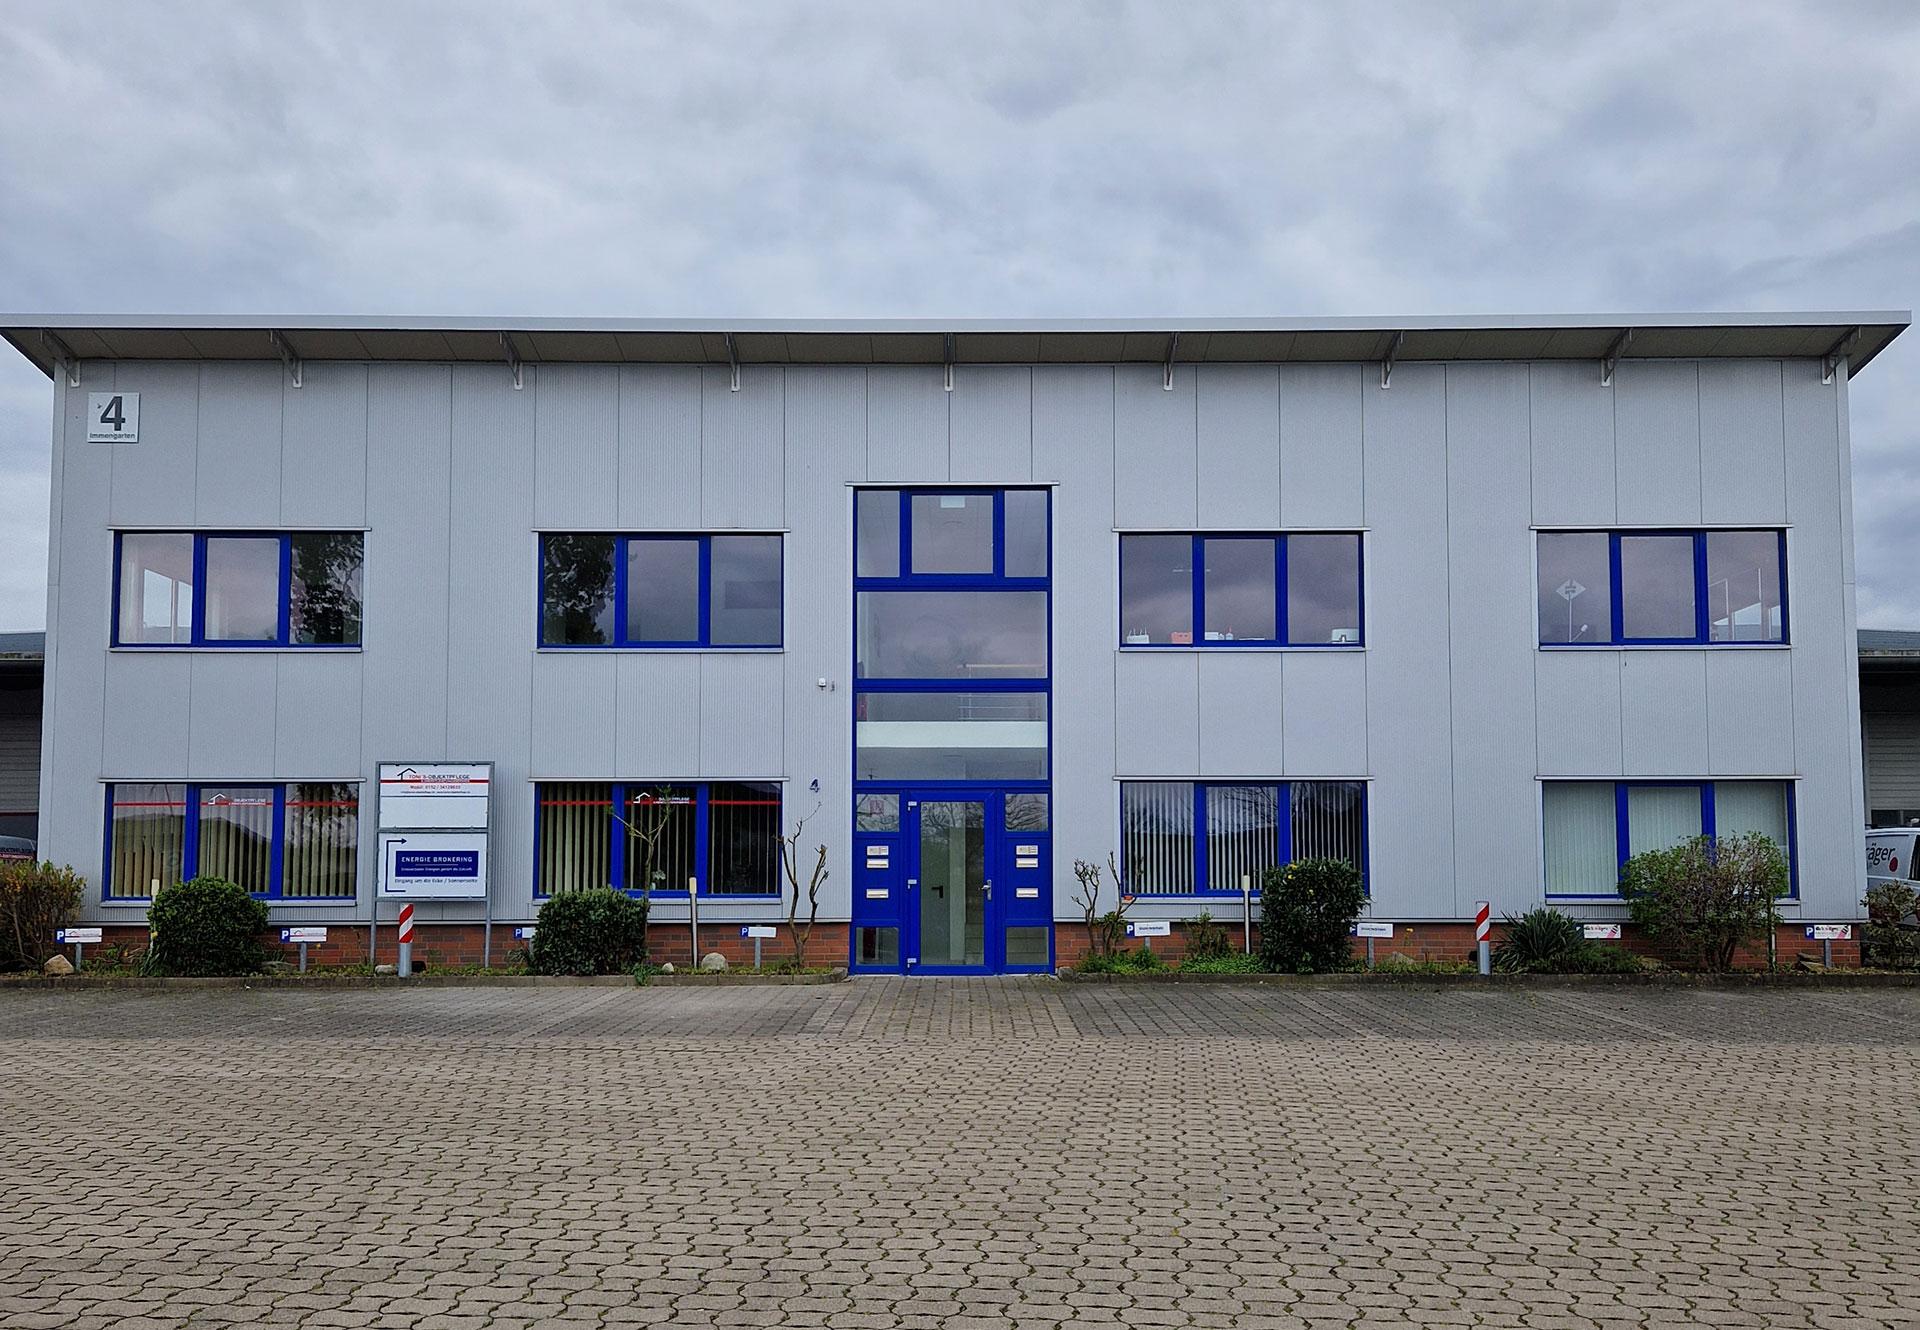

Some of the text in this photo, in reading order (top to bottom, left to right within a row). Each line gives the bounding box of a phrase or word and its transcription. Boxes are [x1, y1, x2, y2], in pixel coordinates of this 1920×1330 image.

[100, 396, 126, 431] 4
[809, 778, 821, 793] 4
[281, 930, 289, 940] P
[1126, 924, 1134, 935] P
[1806, 927, 1813, 936] P
[56, 930, 65, 941] P
